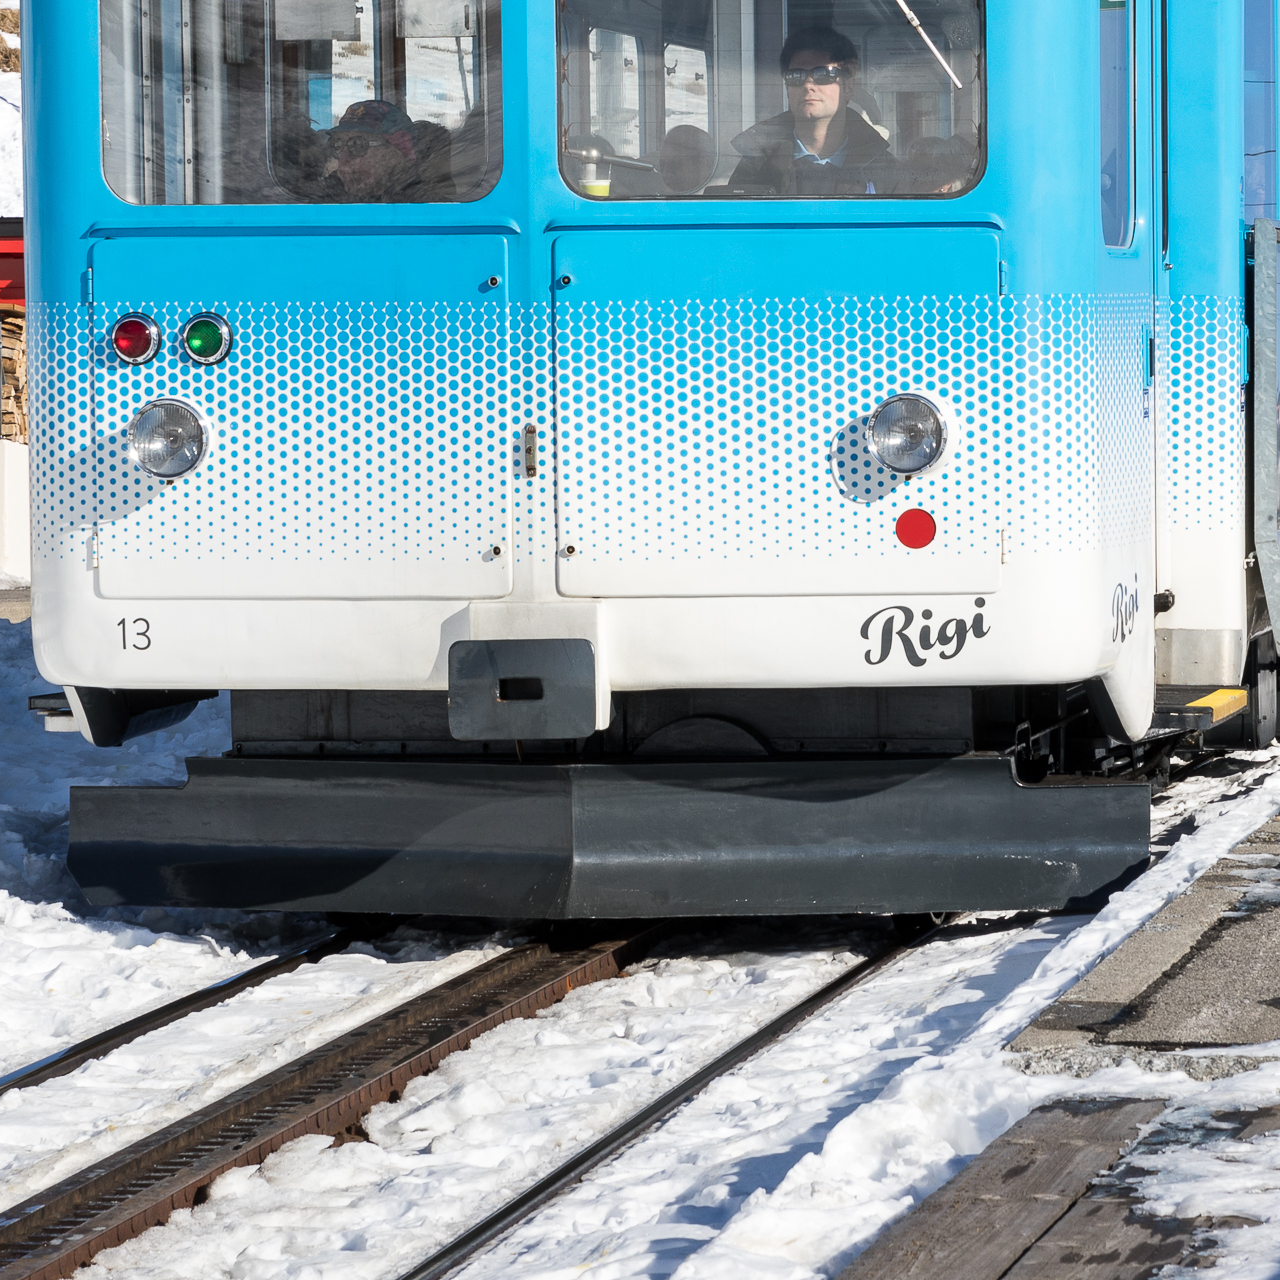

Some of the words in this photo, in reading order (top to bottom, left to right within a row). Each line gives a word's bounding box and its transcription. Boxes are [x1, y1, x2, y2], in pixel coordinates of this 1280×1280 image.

[117, 617, 151, 650] 13
[860, 597, 991, 667] Rigi
[1111, 572, 1139, 643] Rigi
